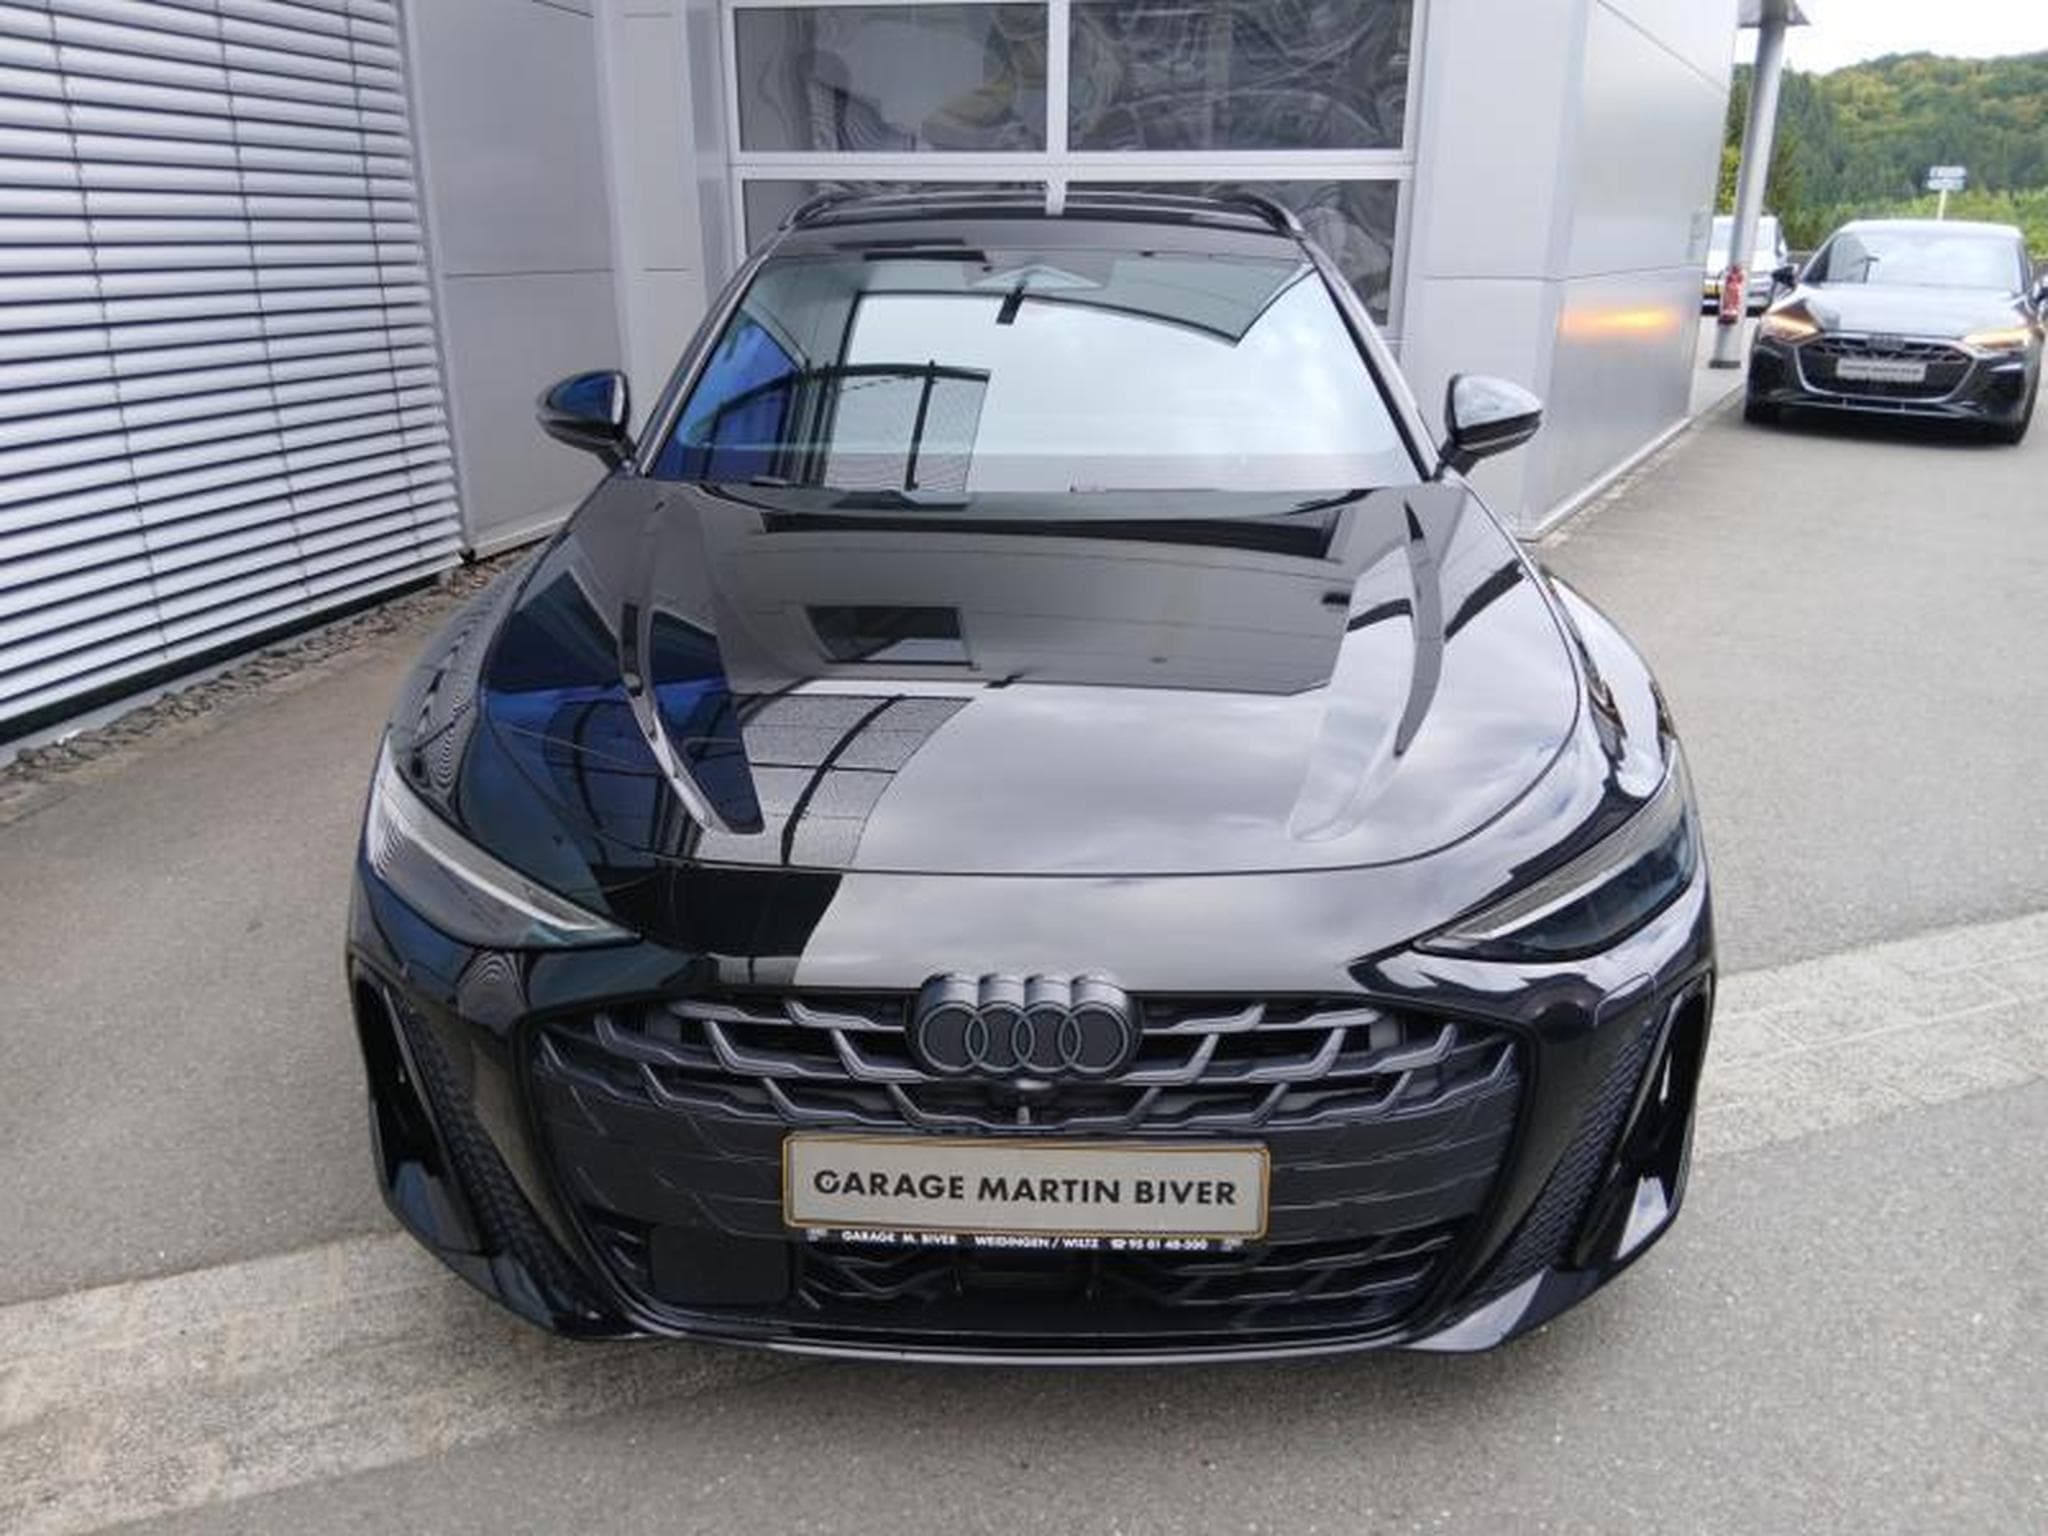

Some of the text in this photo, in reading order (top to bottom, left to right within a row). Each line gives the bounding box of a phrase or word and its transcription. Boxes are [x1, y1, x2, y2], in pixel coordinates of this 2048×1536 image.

[813, 1169, 1237, 1205] GARAGE MARTIN BIVER
[841, 1230, 895, 1243] GARAGE
[921, 1233, 957, 1246] BIVER
